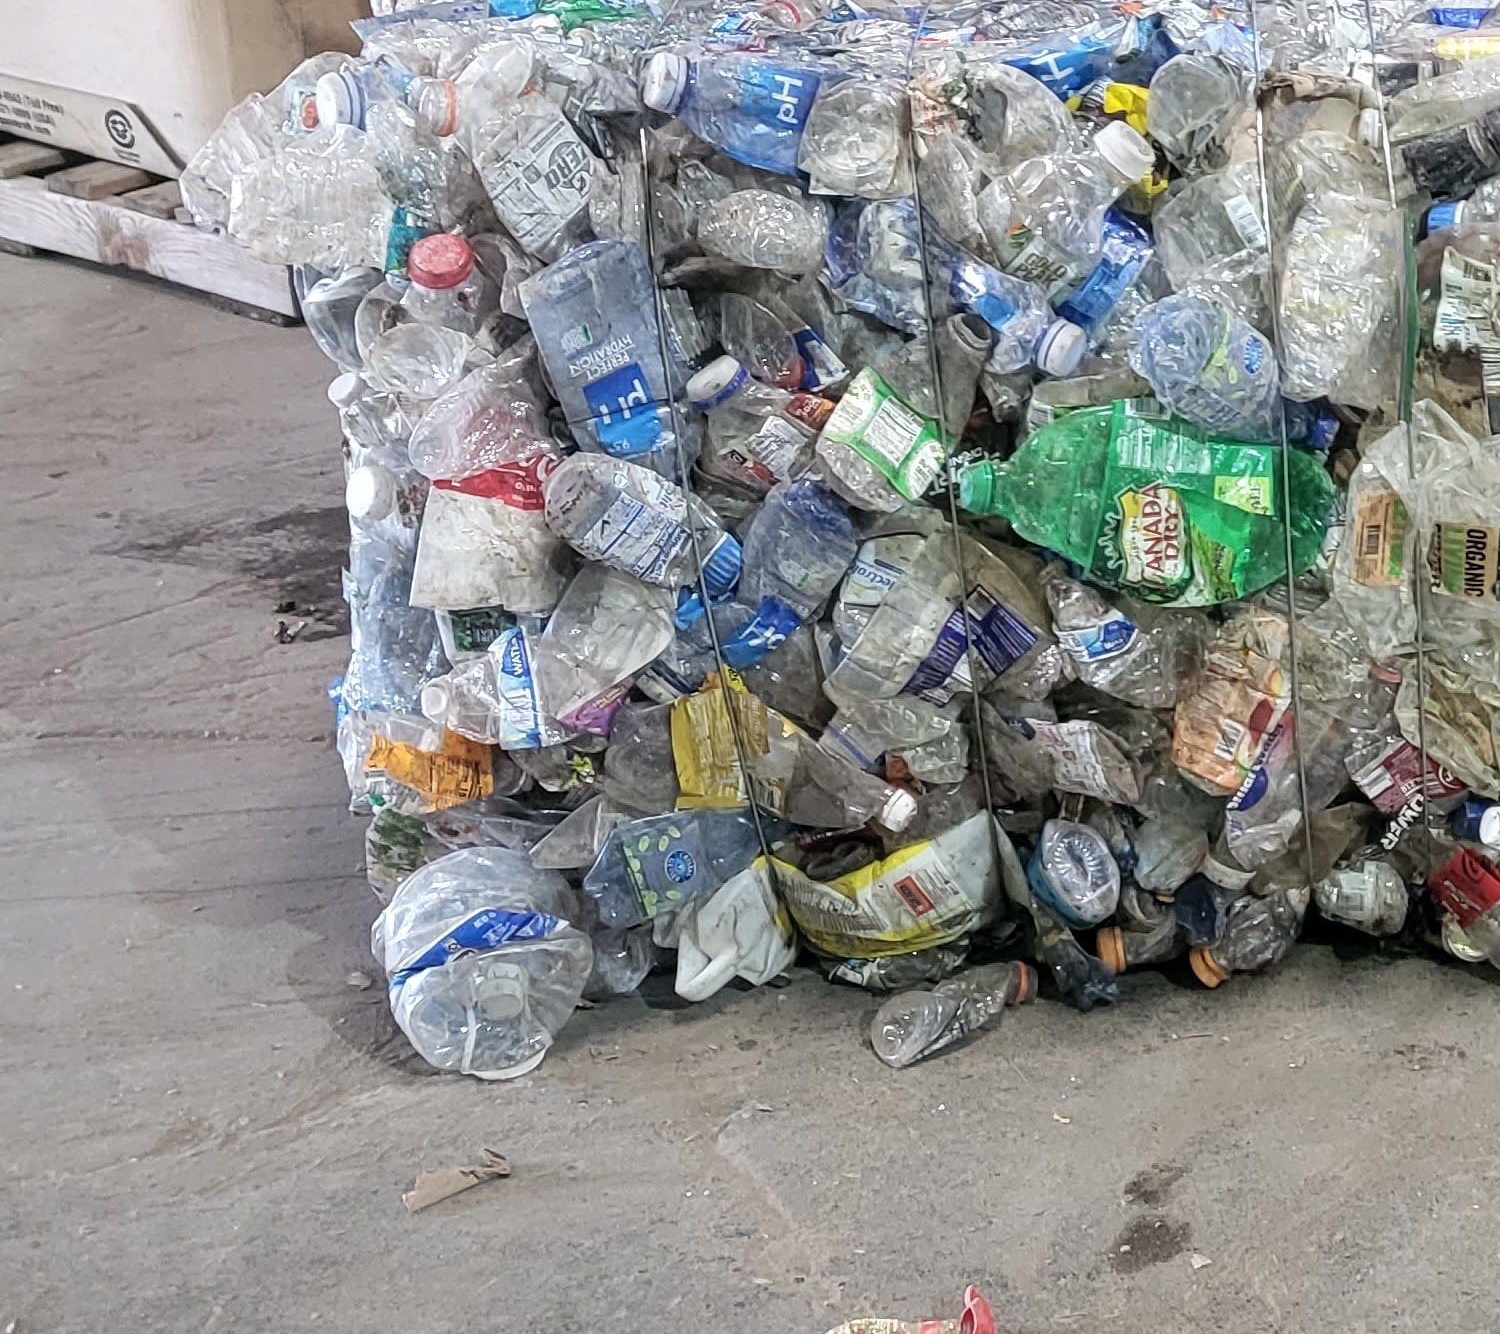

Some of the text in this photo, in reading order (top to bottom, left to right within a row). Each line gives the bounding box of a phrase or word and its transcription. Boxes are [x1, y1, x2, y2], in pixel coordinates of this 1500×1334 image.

[569, 334, 633, 374] HYDRATION
[585, 351, 630, 380] PERFECT
[1464, 528, 1488, 598] ORGANIC
[1379, 793, 1425, 851] OWER
